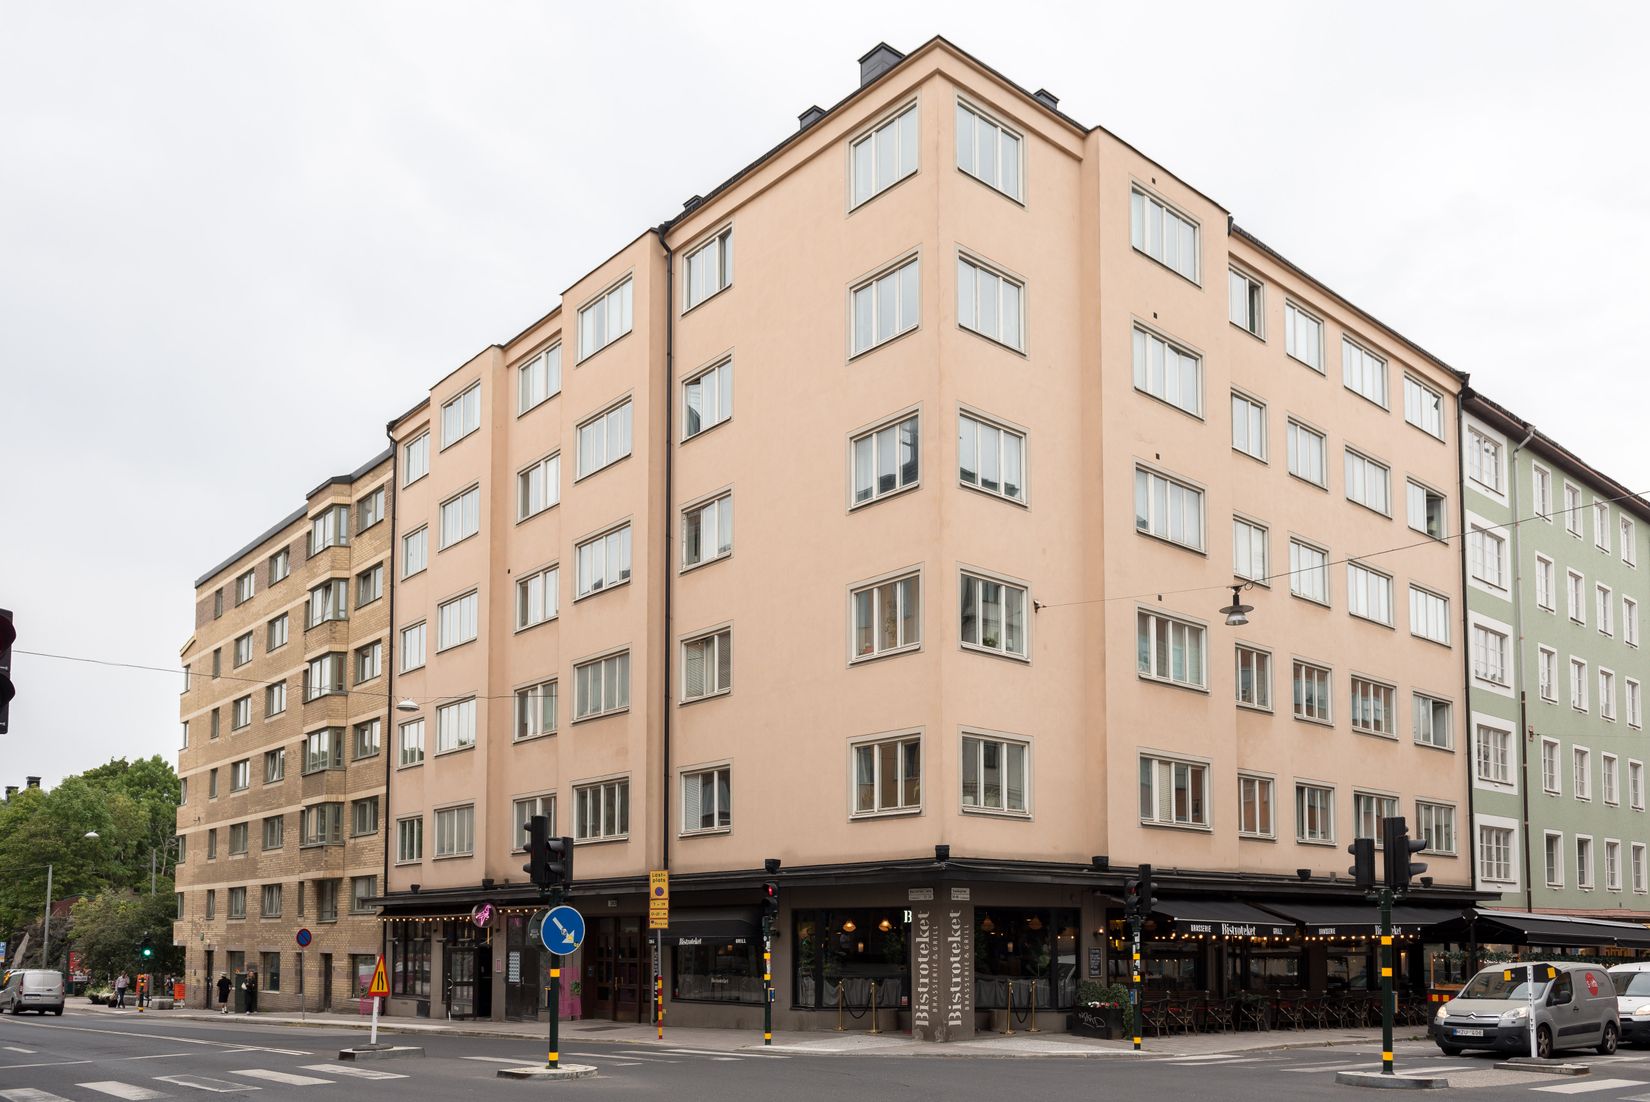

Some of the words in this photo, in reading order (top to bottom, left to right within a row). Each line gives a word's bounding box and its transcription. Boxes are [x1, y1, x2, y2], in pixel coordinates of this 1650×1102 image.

[916, 911, 930, 1026] Bistroteket
[948, 910, 962, 1026] Bistroteket
[1190, 924, 1211, 933] BRASSERIE
[1221, 923, 1256, 936] Bistroteket
